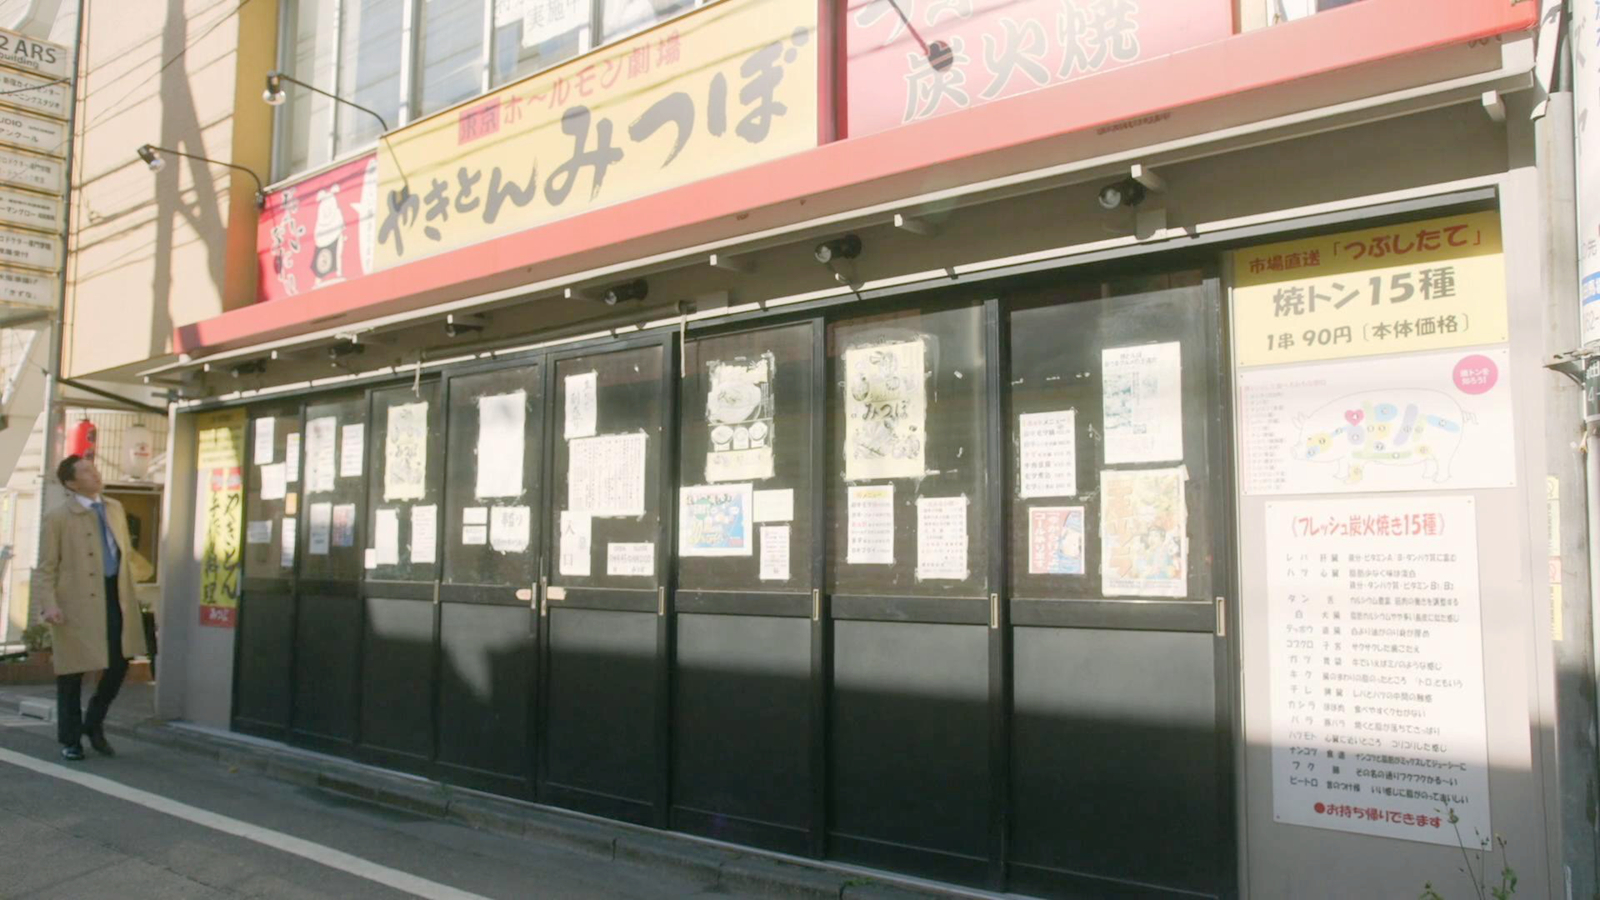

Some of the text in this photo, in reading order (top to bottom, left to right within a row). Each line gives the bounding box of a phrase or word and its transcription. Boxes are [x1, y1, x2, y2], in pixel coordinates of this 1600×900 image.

[14, 40, 56, 64] ARS
[901, 0, 1140, 124] 炭火焼
[543, 26, 809, 206] みつぼ
[1249, 223, 1481, 274] 市場直送 「つぶしたて」
[1302, 326, 1352, 346] 90円
[1295, 609, 1303, 619] 白
[1289, 746, 1318, 756] ナンコツ
[1326, 803, 1443, 828] お持ち帰りできます
